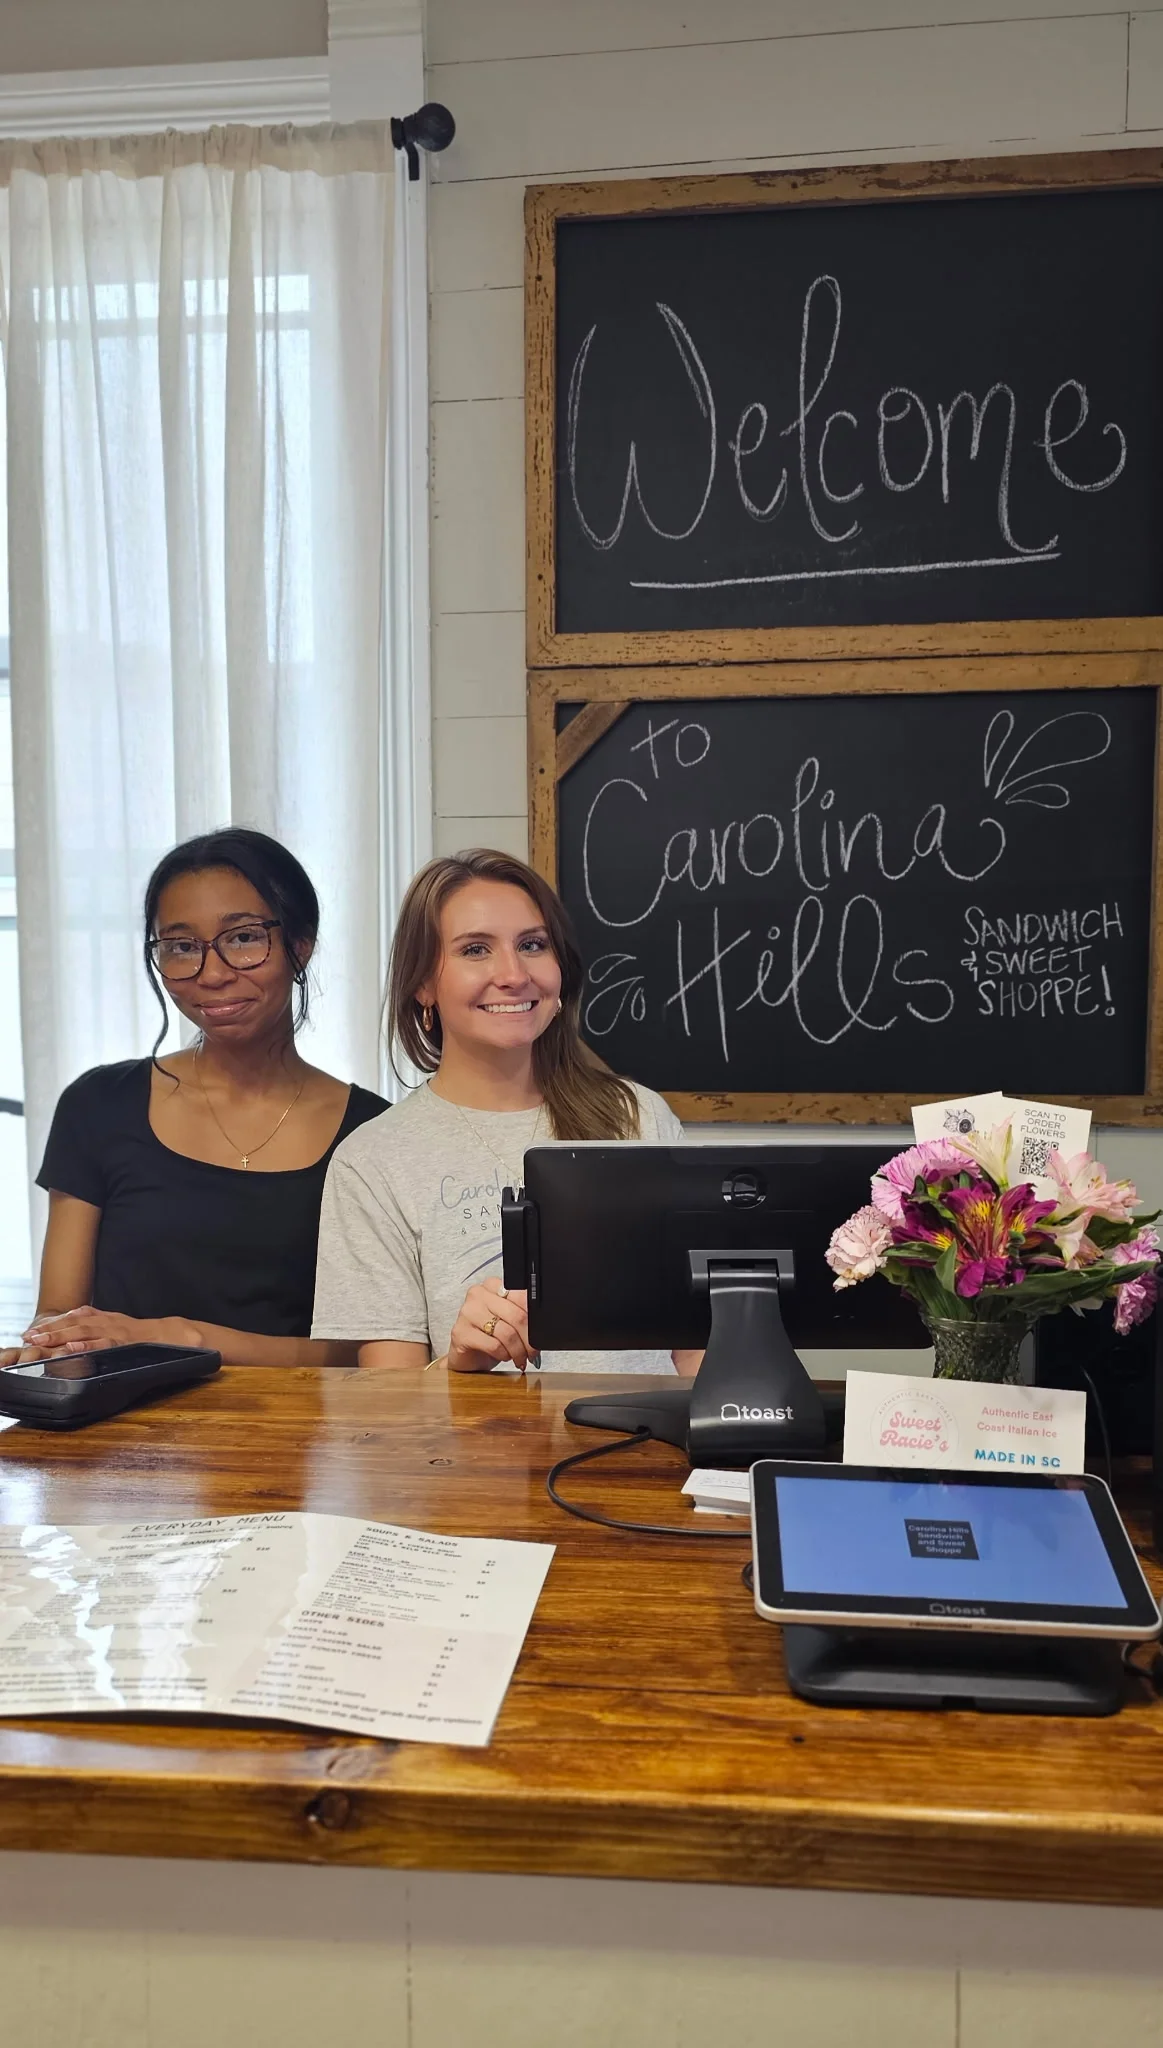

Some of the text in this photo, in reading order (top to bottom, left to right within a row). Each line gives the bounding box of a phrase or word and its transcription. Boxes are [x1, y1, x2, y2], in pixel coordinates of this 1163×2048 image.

[568, 274, 1127, 553] Welcome
[583, 757, 1006, 927] Carolina
[963, 901, 1123, 948] SANDWICH
[985, 945, 1092, 975] SWEET
[666, 894, 954, 1063] Hills
[978, 962, 1116, 1017] SHOPPE!
[1024, 1108, 1067, 1122] SCAN TO
[1027, 1117, 1062, 1130] ORDER
[1020, 1126, 1066, 1139] FLOWERS
[740, 1405, 795, 1420] toast
[889, 1411, 942, 1432] Sweet
[981, 1406, 1054, 1422] Authentic East
[976, 1421, 1058, 1438] Coast Italian Ice
[879, 1430, 950, 1453] Racie's
[974, 1448, 1016, 1464] MADE
[1020, 1454, 1036, 1466] IN
[131, 1514, 287, 1533] EVERYDAY MENU
[908, 1524, 970, 1534] Carolina Hills
[366, 1526, 399, 1537] SOUPS
[418, 1537, 459, 1547] SALADS
[917, 1531, 963, 1540] Sandwich
[925, 1546, 962, 1555] Shoppe
[301, 1609, 385, 1628] OTHER SIDES
[945, 1605, 987, 1616] toast
